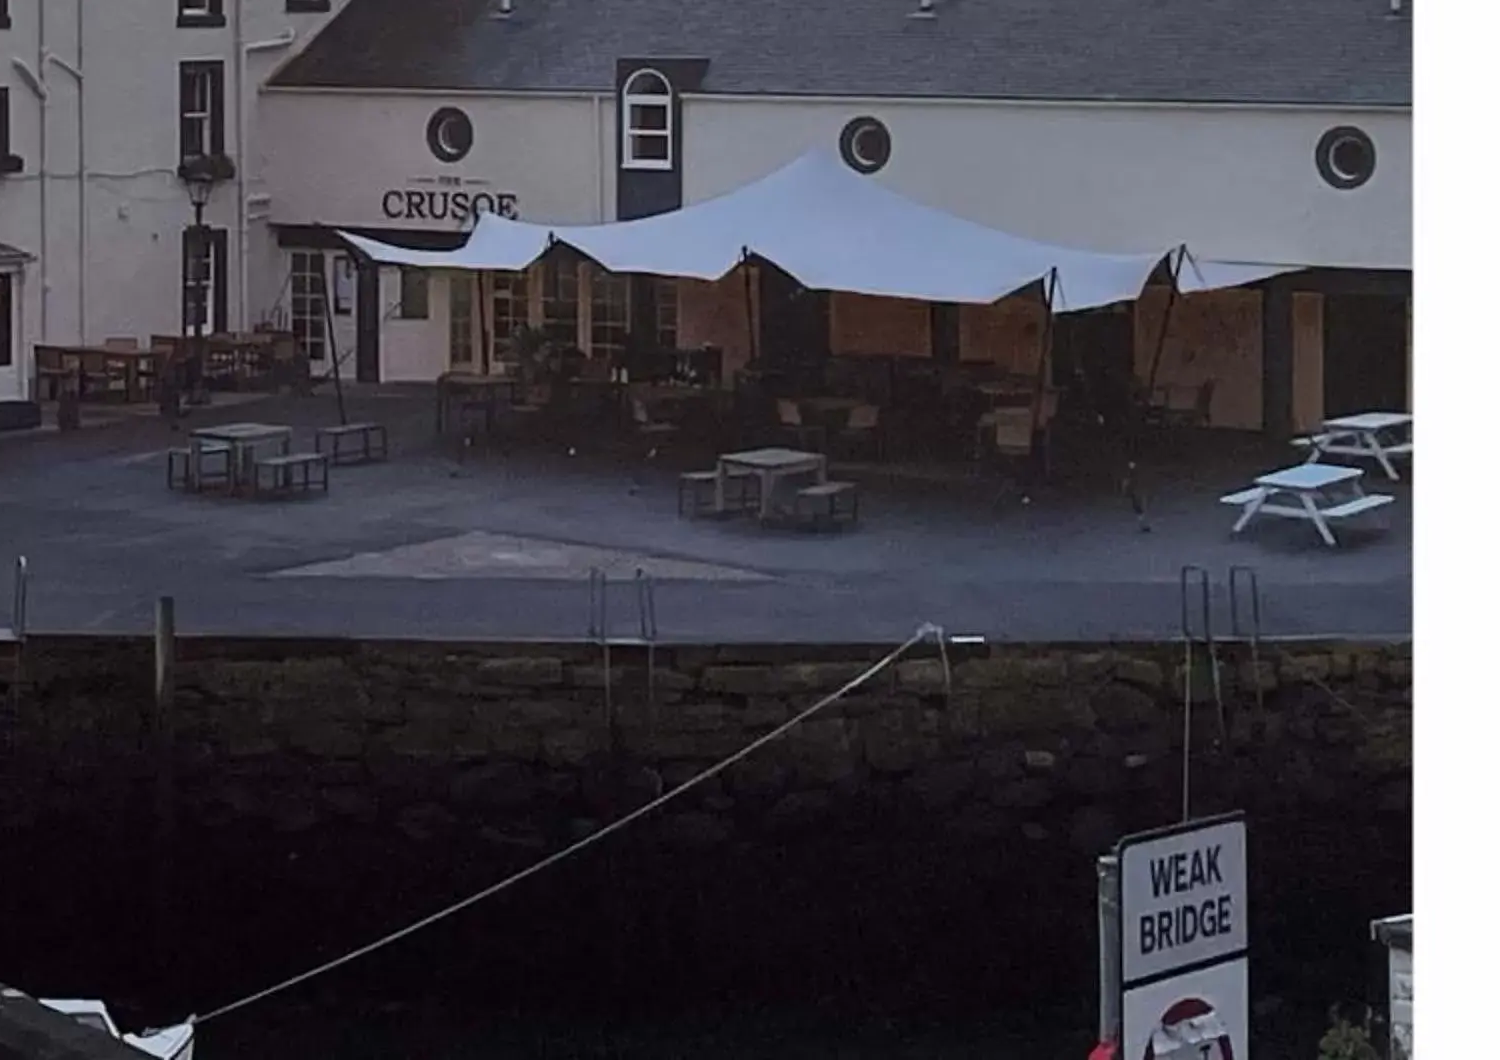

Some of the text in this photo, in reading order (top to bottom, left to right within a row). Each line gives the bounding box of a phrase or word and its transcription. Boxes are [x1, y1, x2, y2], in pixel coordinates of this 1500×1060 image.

[382, 190, 519, 221] CRUSOE
[1150, 844, 1223, 897] WEAK
[1140, 895, 1232, 956] BRIDGE
